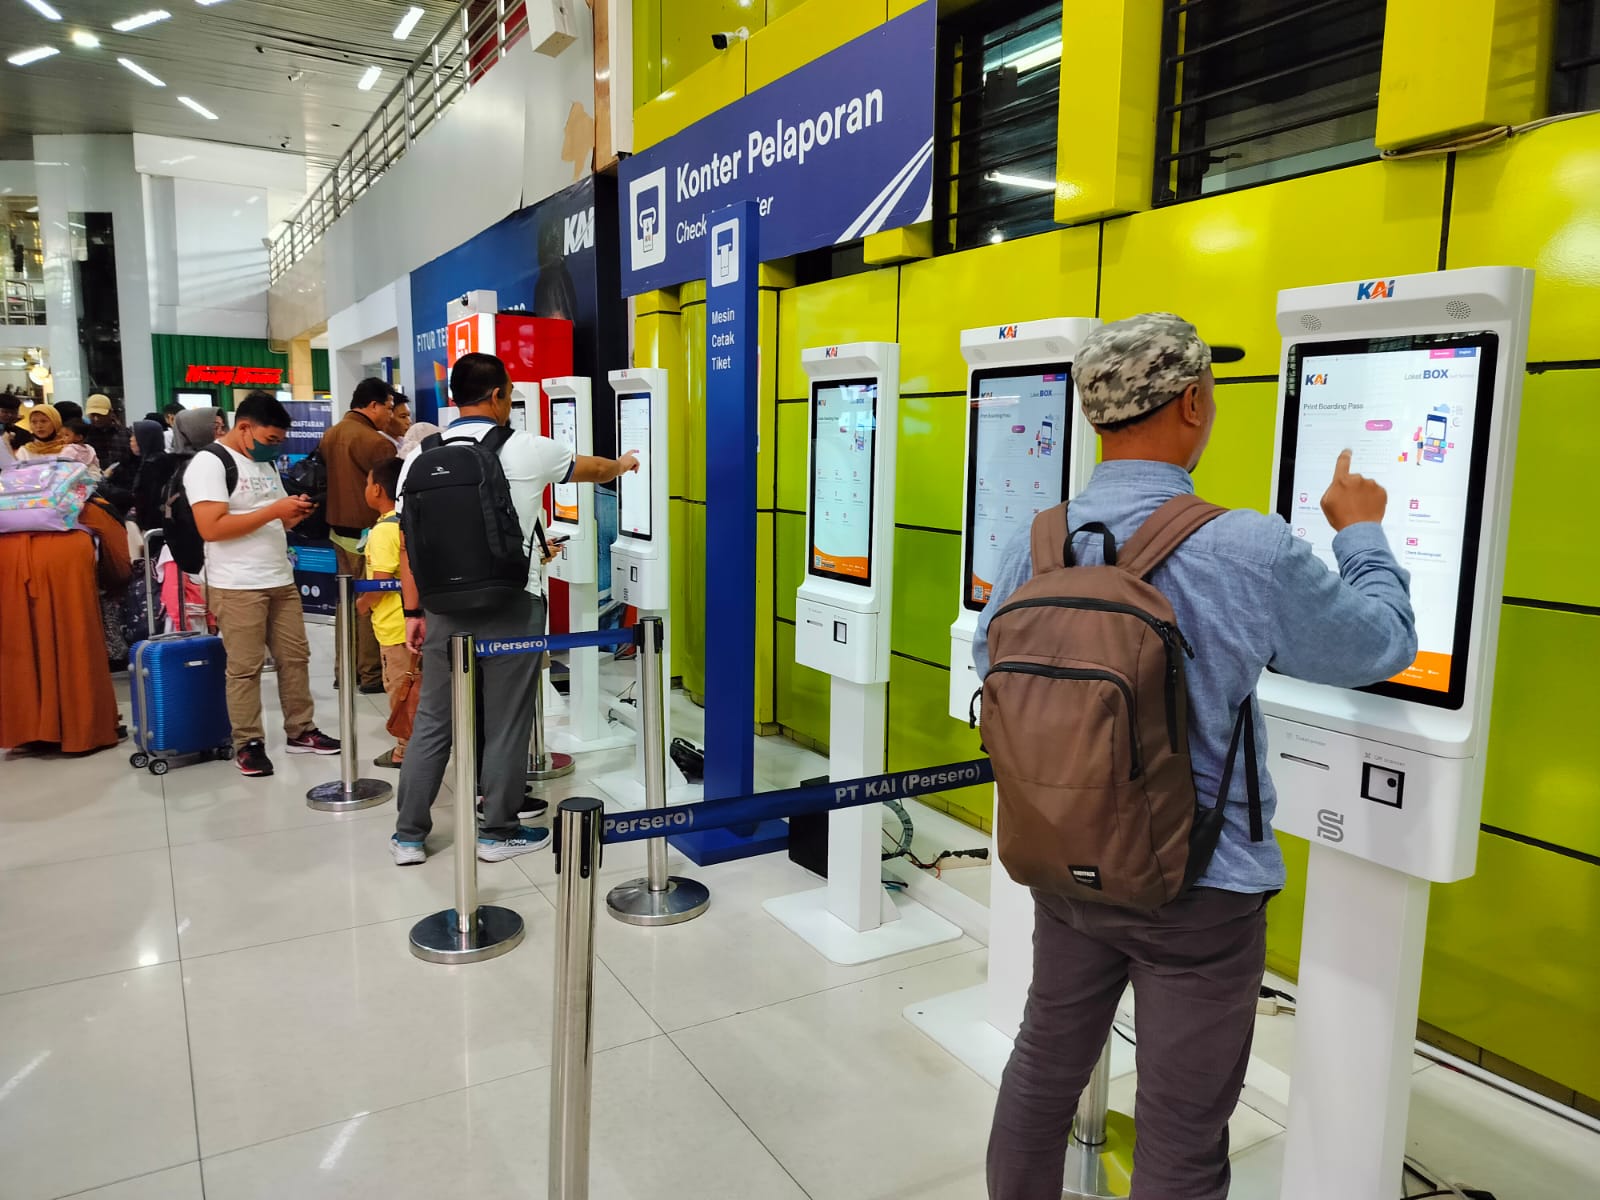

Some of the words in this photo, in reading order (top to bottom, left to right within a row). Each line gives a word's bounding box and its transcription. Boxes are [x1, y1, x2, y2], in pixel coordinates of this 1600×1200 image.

[677, 149, 742, 203] Konter
[748, 88, 883, 174] Pelaporan
[676, 213, 707, 244] Check
[712, 307, 735, 325] Mesin
[416, 330, 436, 353] FITUR
[712, 331, 735, 347] Cetak
[712, 355, 731, 370] Tiket
[1423, 369, 1448, 379] BOX
[1319, 403, 1347, 411] Boarding
[379, 581, 393, 589] PT
[489, 638, 548, 654] (Persero)
[835, 786, 857, 803] PT
[865, 782, 896, 799] KAI
[902, 765, 981, 794] (Persero)
